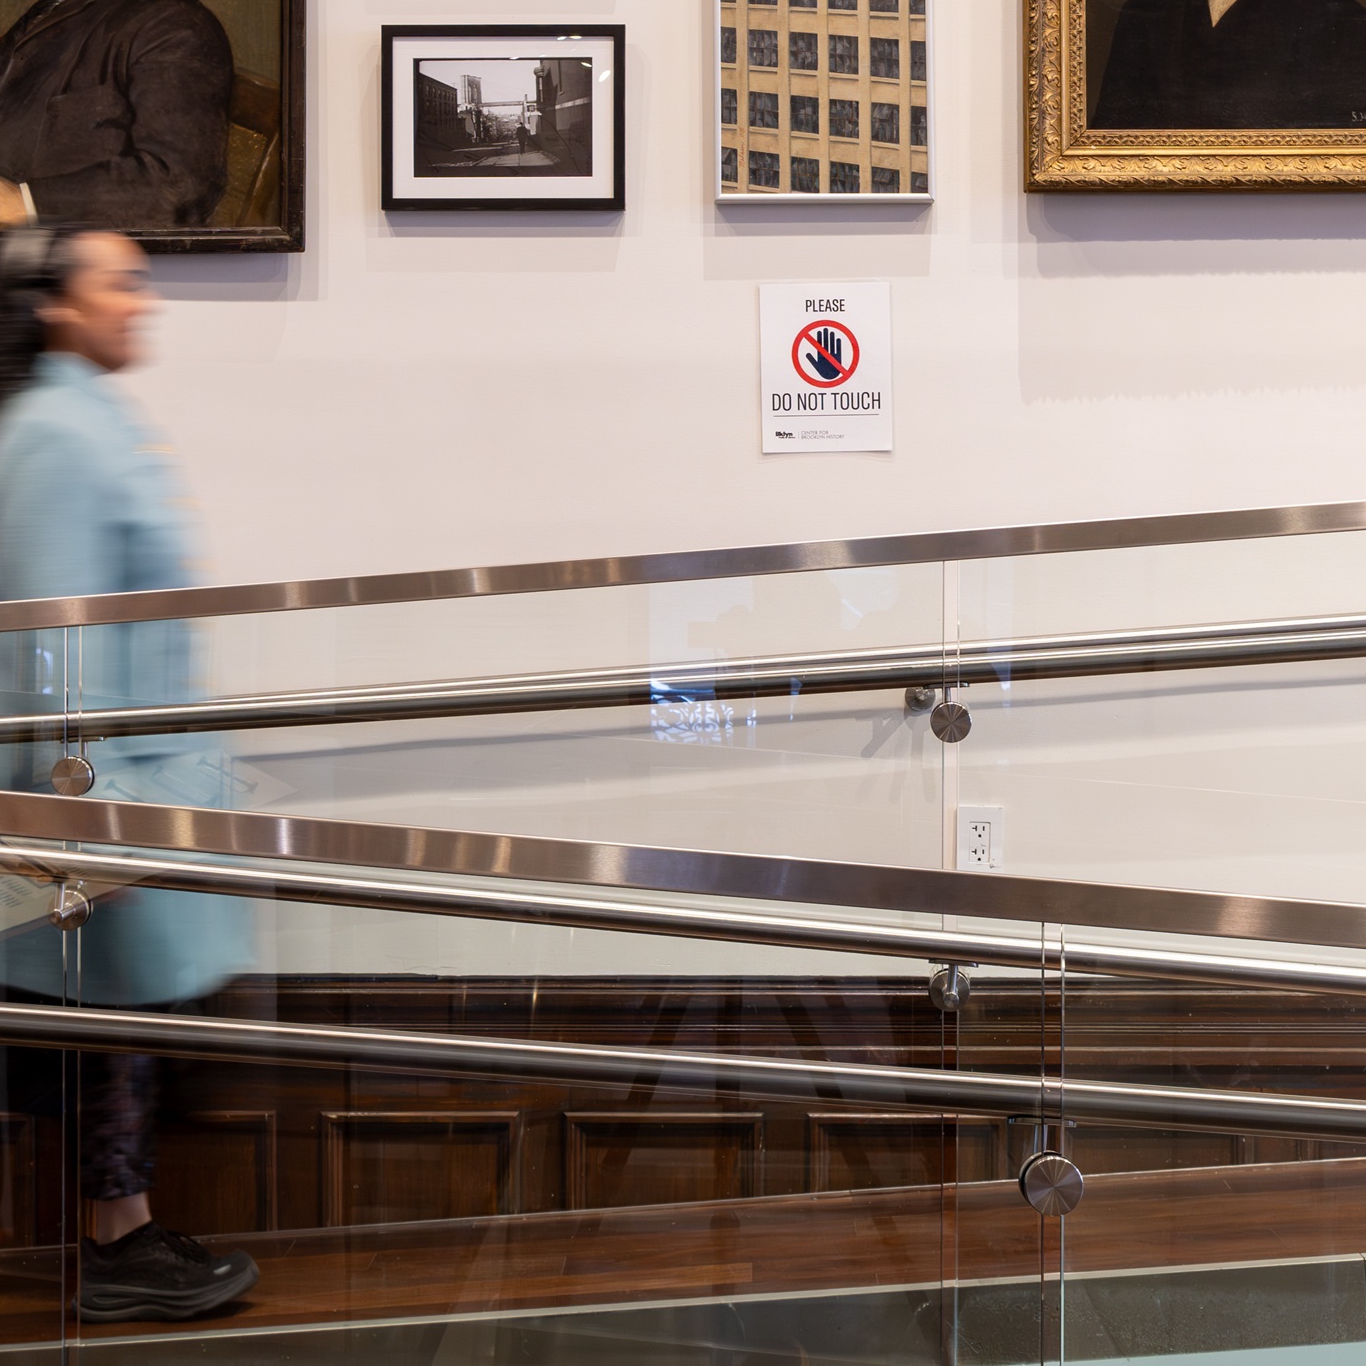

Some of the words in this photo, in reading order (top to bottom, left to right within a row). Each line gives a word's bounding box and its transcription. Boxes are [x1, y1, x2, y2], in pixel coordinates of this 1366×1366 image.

[805, 299, 846, 313] PLEASE
[772, 392, 792, 411] DO
[797, 392, 827, 411] NOT
[830, 391, 881, 410] TOUCH
